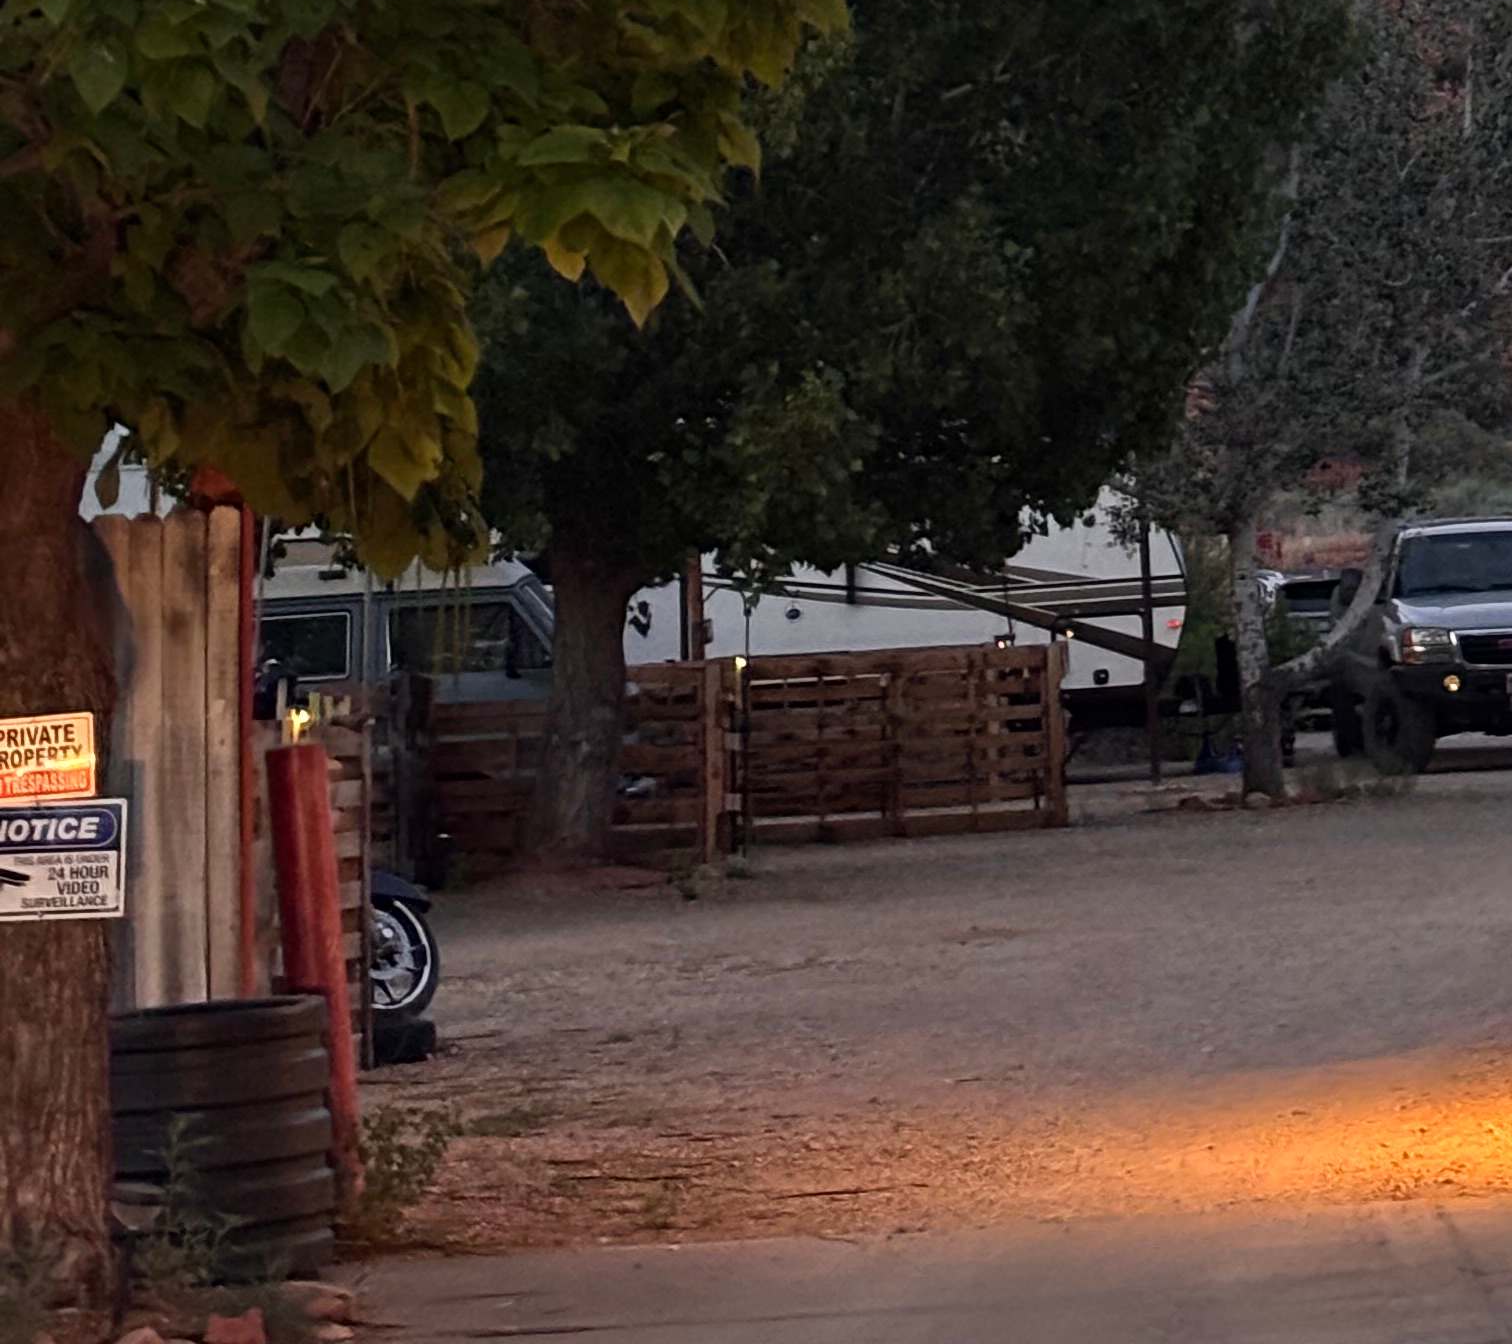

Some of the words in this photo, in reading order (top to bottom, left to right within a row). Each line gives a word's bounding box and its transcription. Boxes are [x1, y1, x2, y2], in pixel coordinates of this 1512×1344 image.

[48, 867, 66, 880] 24
[69, 865, 110, 879] HOUR
[57, 880, 100, 895] VIDEO
[20, 895, 109, 909] SURVEILLANCE
